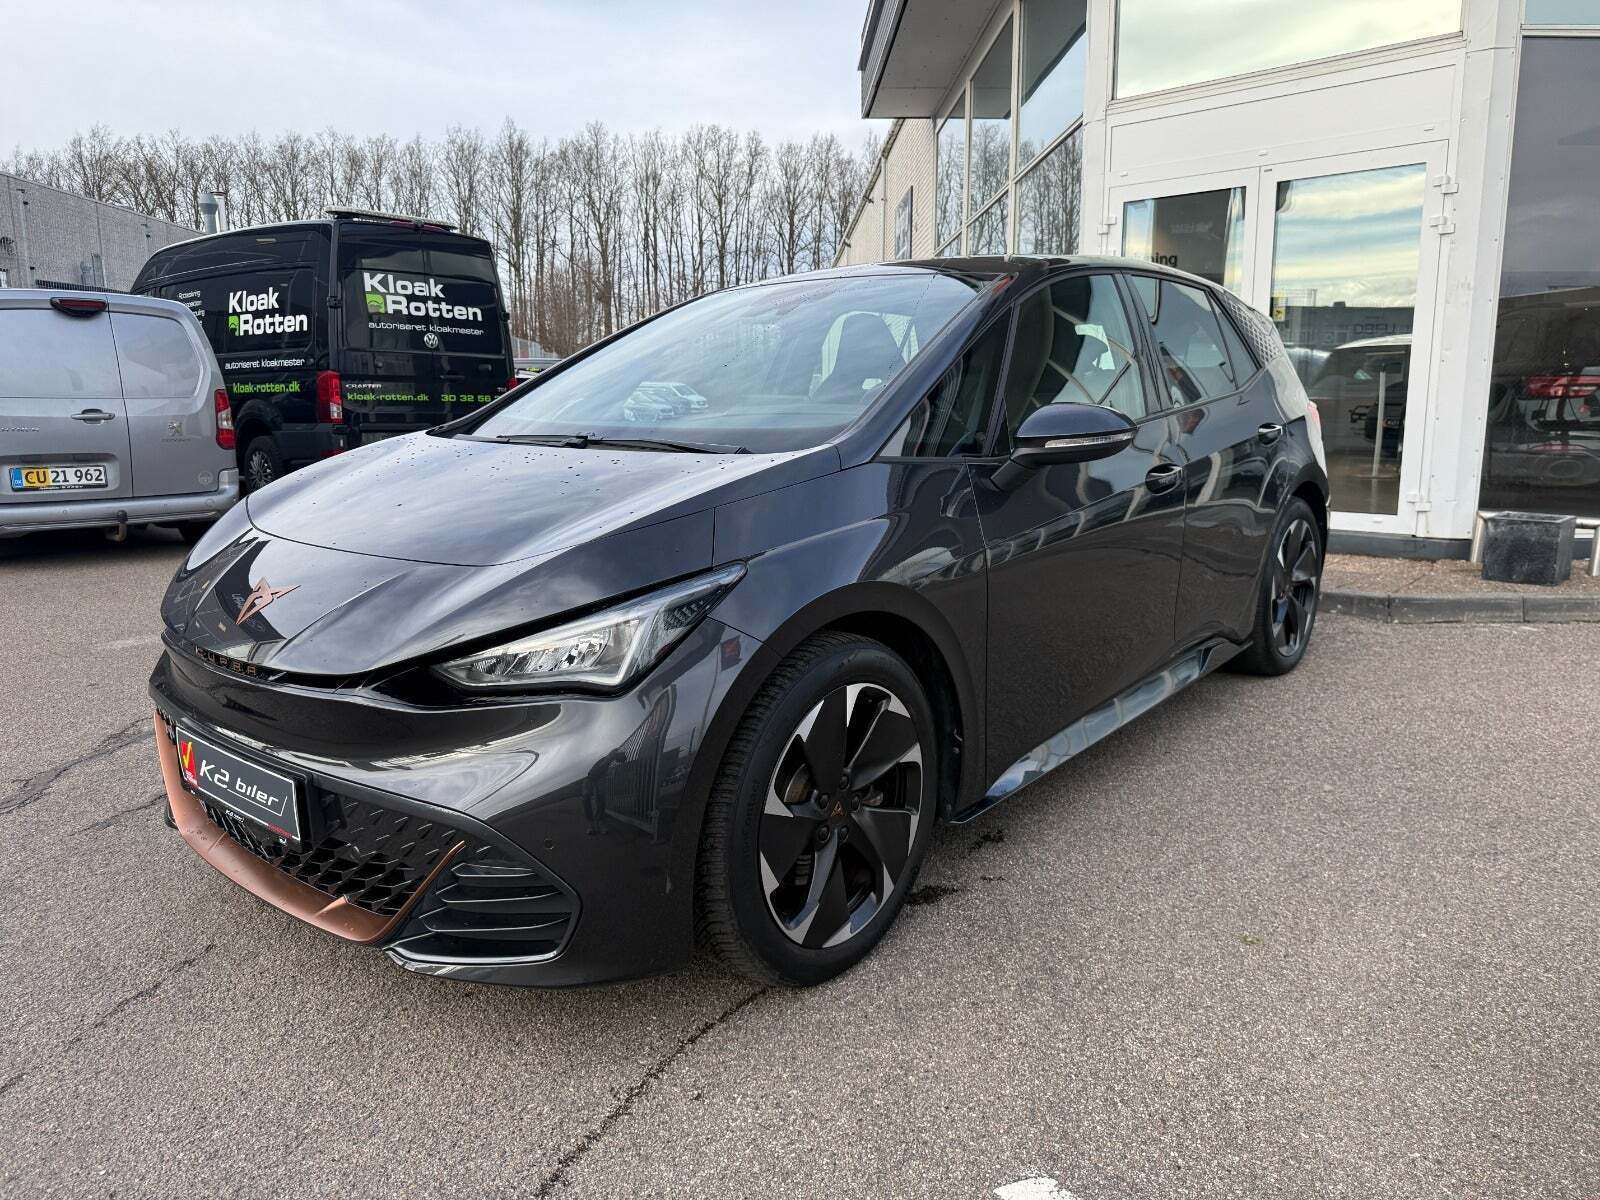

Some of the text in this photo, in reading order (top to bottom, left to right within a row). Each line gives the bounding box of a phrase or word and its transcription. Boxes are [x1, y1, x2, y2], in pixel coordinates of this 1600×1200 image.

[364, 272, 445, 298] Kloak
[228, 287, 279, 314] Kloak
[386, 294, 482, 321] Rotten
[240, 313, 308, 336] Rotten
[368, 321, 484, 335] autoriseret kloakmester
[225, 358, 305, 370] autoriseret kloakmester
[233, 381, 300, 393] kloak-rotten.dk
[347, 392, 430, 402] kloak-rotten.dk
[441, 394, 456, 402] 30
[459, 394, 475, 402] 32
[477, 394, 492, 403] 56
[25, 469, 103, 484] CU 21 962
[199, 759, 230, 789] K2
[235, 777, 279, 806] biler
